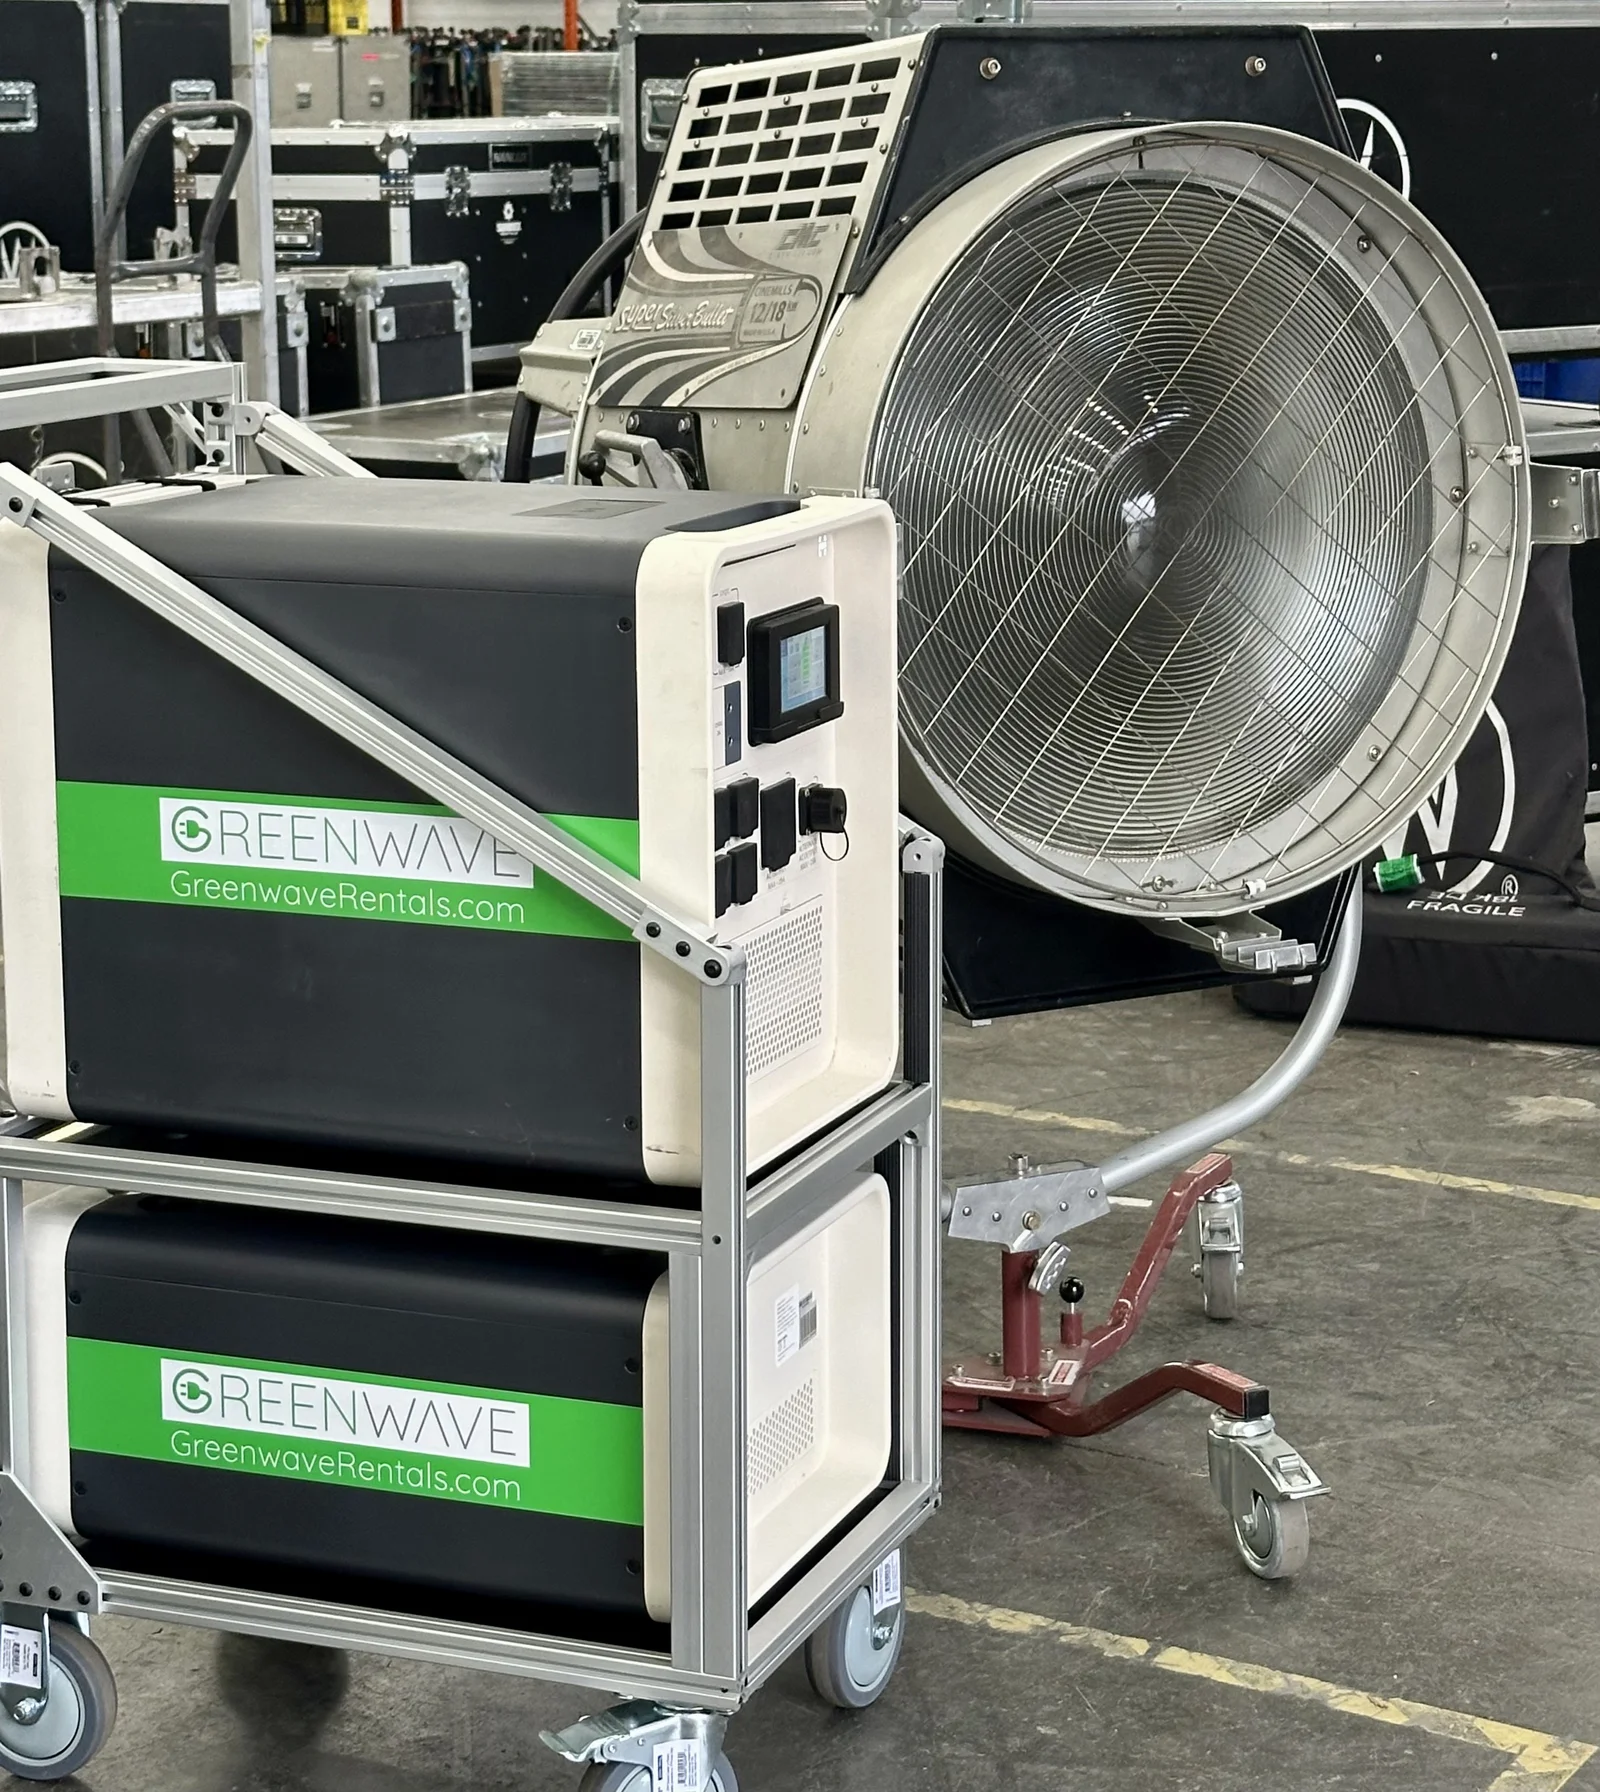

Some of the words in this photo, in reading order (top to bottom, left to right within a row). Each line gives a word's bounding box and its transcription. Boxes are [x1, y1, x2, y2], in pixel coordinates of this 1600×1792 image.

[754, 284, 793, 297] CINEMILLS
[691, 300, 735, 328] Bullet
[750, 300, 787, 324] 12/18
[171, 806, 521, 878] GREENWAVE
[170, 870, 525, 925] GreenwaveRentals.com
[1406, 899, 1527, 918] FRAGILE
[171, 1368, 517, 1457] GREENWAVE
[170, 1430, 522, 1502] GreenwaveRentals.com
